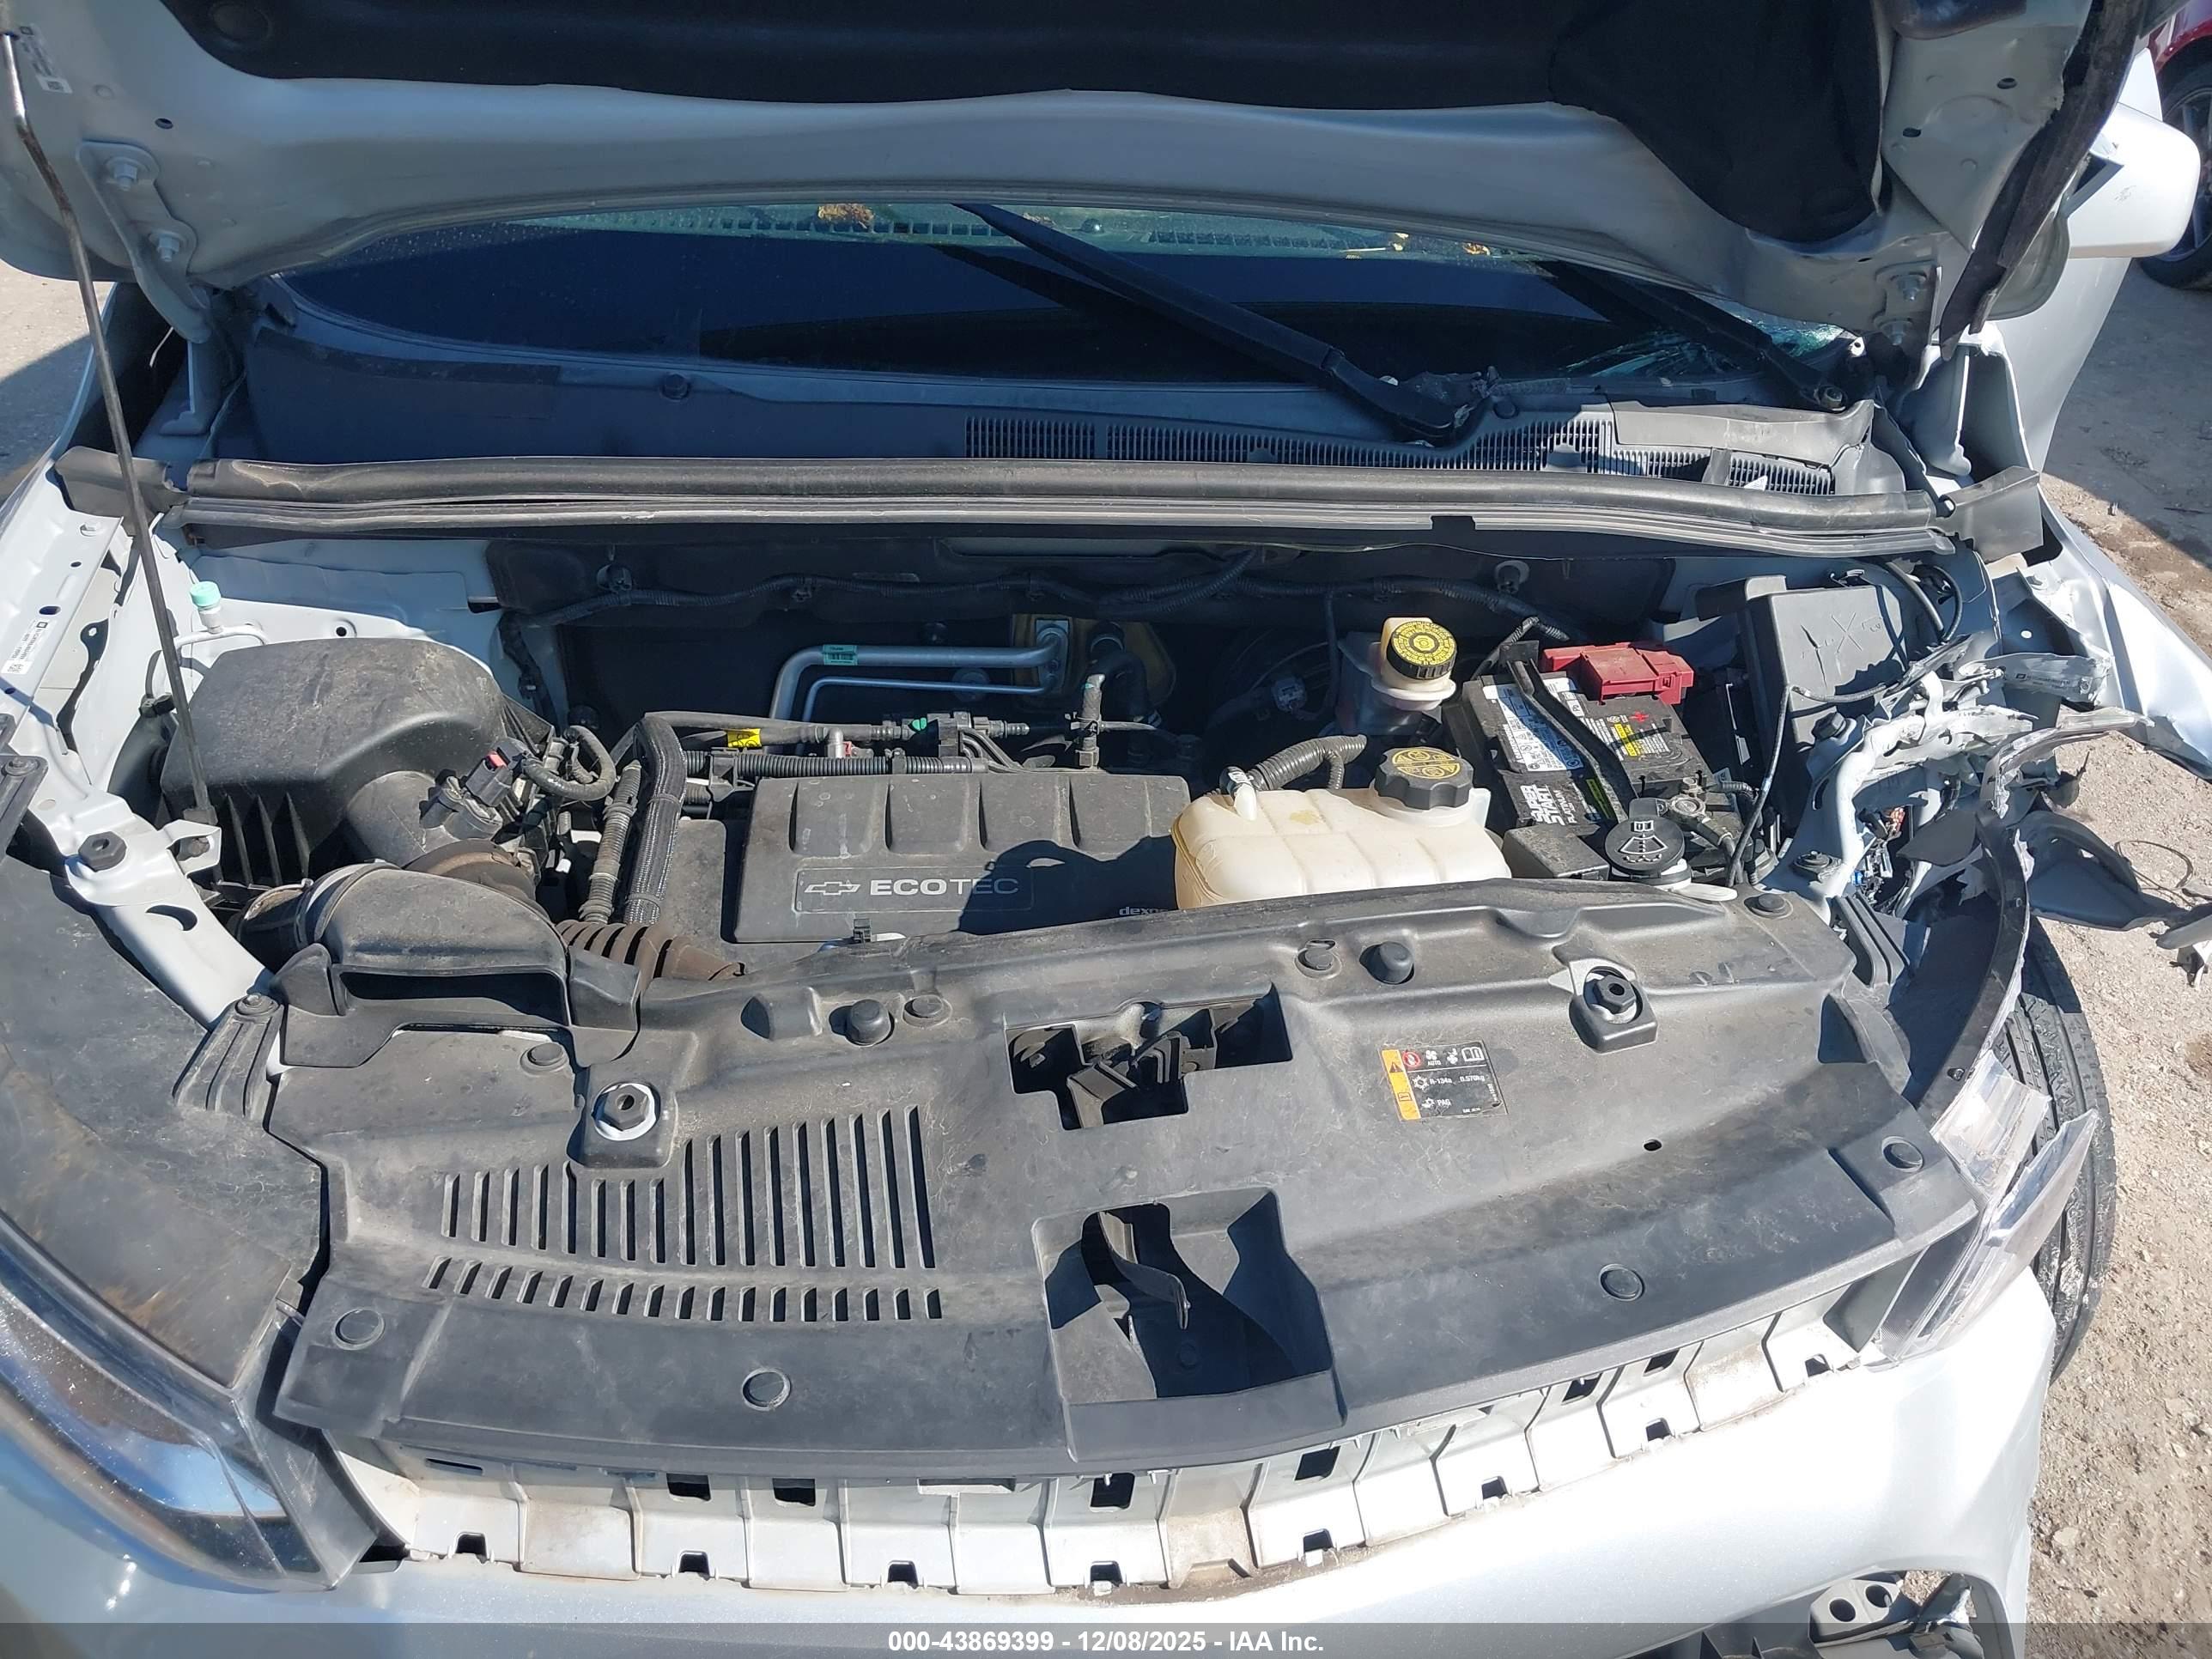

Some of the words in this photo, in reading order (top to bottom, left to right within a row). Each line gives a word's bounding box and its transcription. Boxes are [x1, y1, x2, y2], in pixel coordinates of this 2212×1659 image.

[1520, 785, 1543, 822] SUPER
[1533, 783, 1565, 825] START
[870, 878, 1019, 896] ECOTEC
[1119, 906, 1169, 915] dexo
